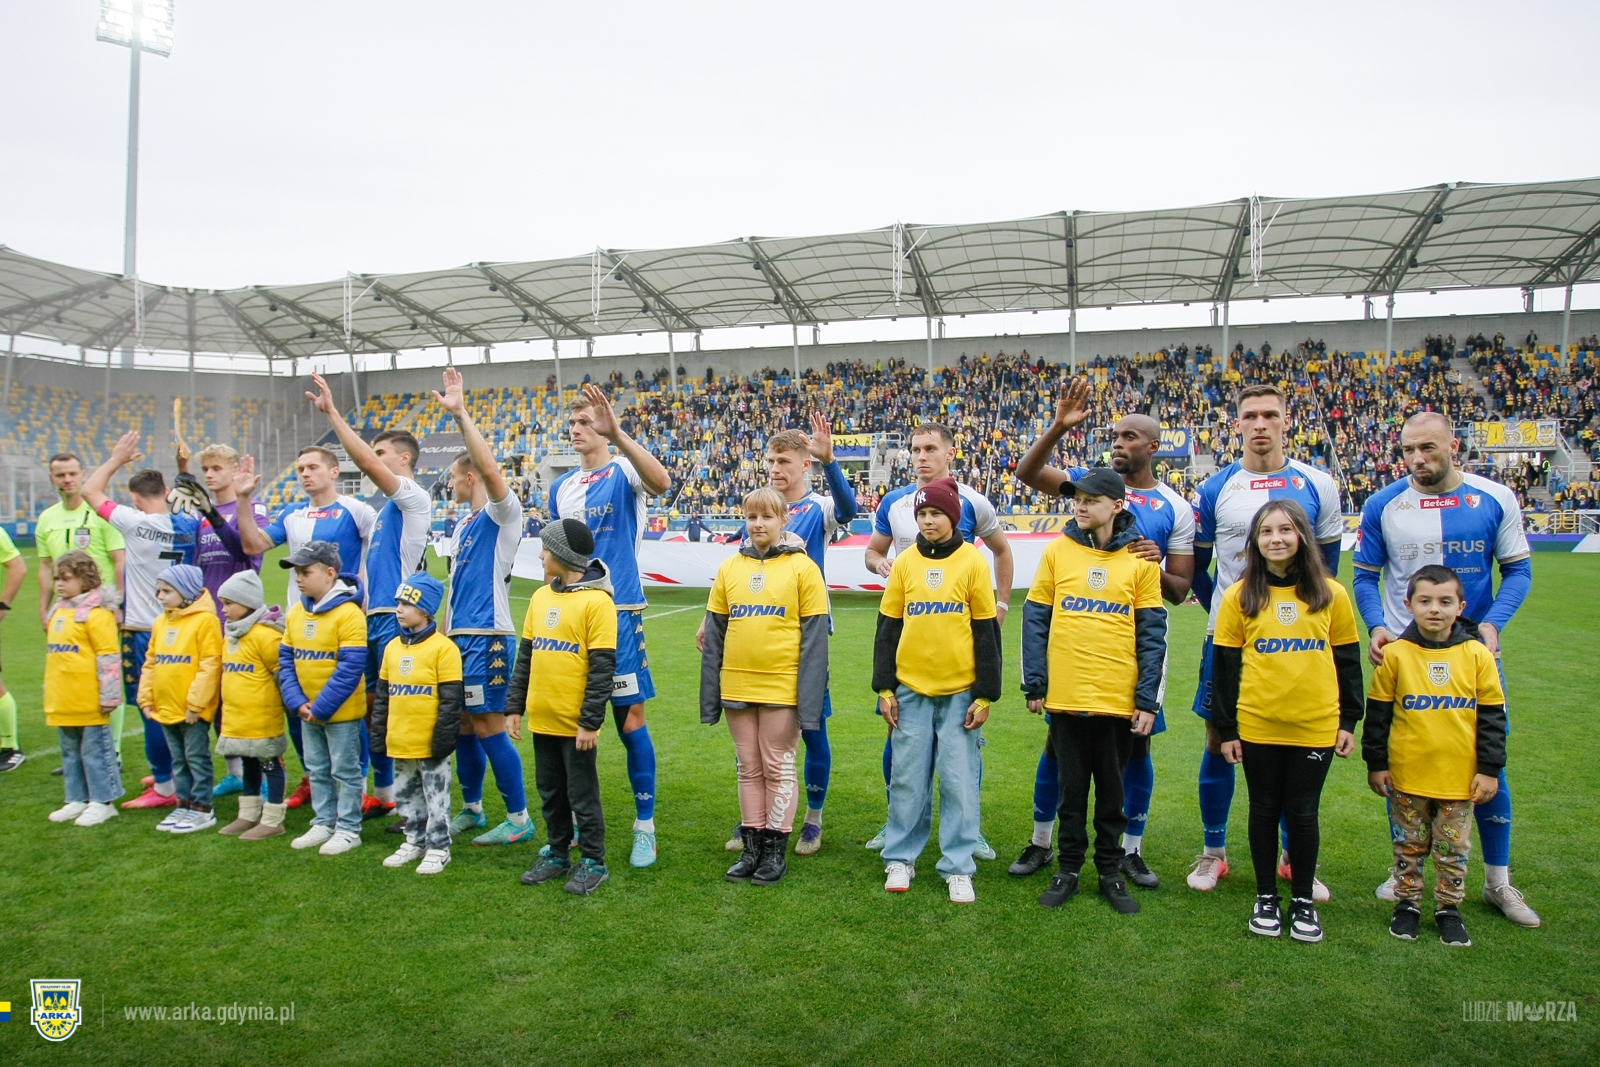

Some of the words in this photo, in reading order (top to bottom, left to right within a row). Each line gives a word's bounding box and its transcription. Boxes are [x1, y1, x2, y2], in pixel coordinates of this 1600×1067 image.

[1159, 430, 1186, 448] INO
[1253, 479, 1283, 489] Betclic
[1423, 499, 1456, 508] Betclic
[1423, 540, 1485, 554] STRUS
[401, 585, 422, 604] 29
[730, 604, 786, 618] GDYNIA
[907, 601, 964, 616] GDYNIA
[1061, 595, 1131, 616] GDYNIA
[1254, 637, 1325, 654] GDYNIA
[293, 648, 336, 660] DYNIA
[222, 662, 255, 673] YNIA
[1402, 694, 1477, 710] GDYNIA
